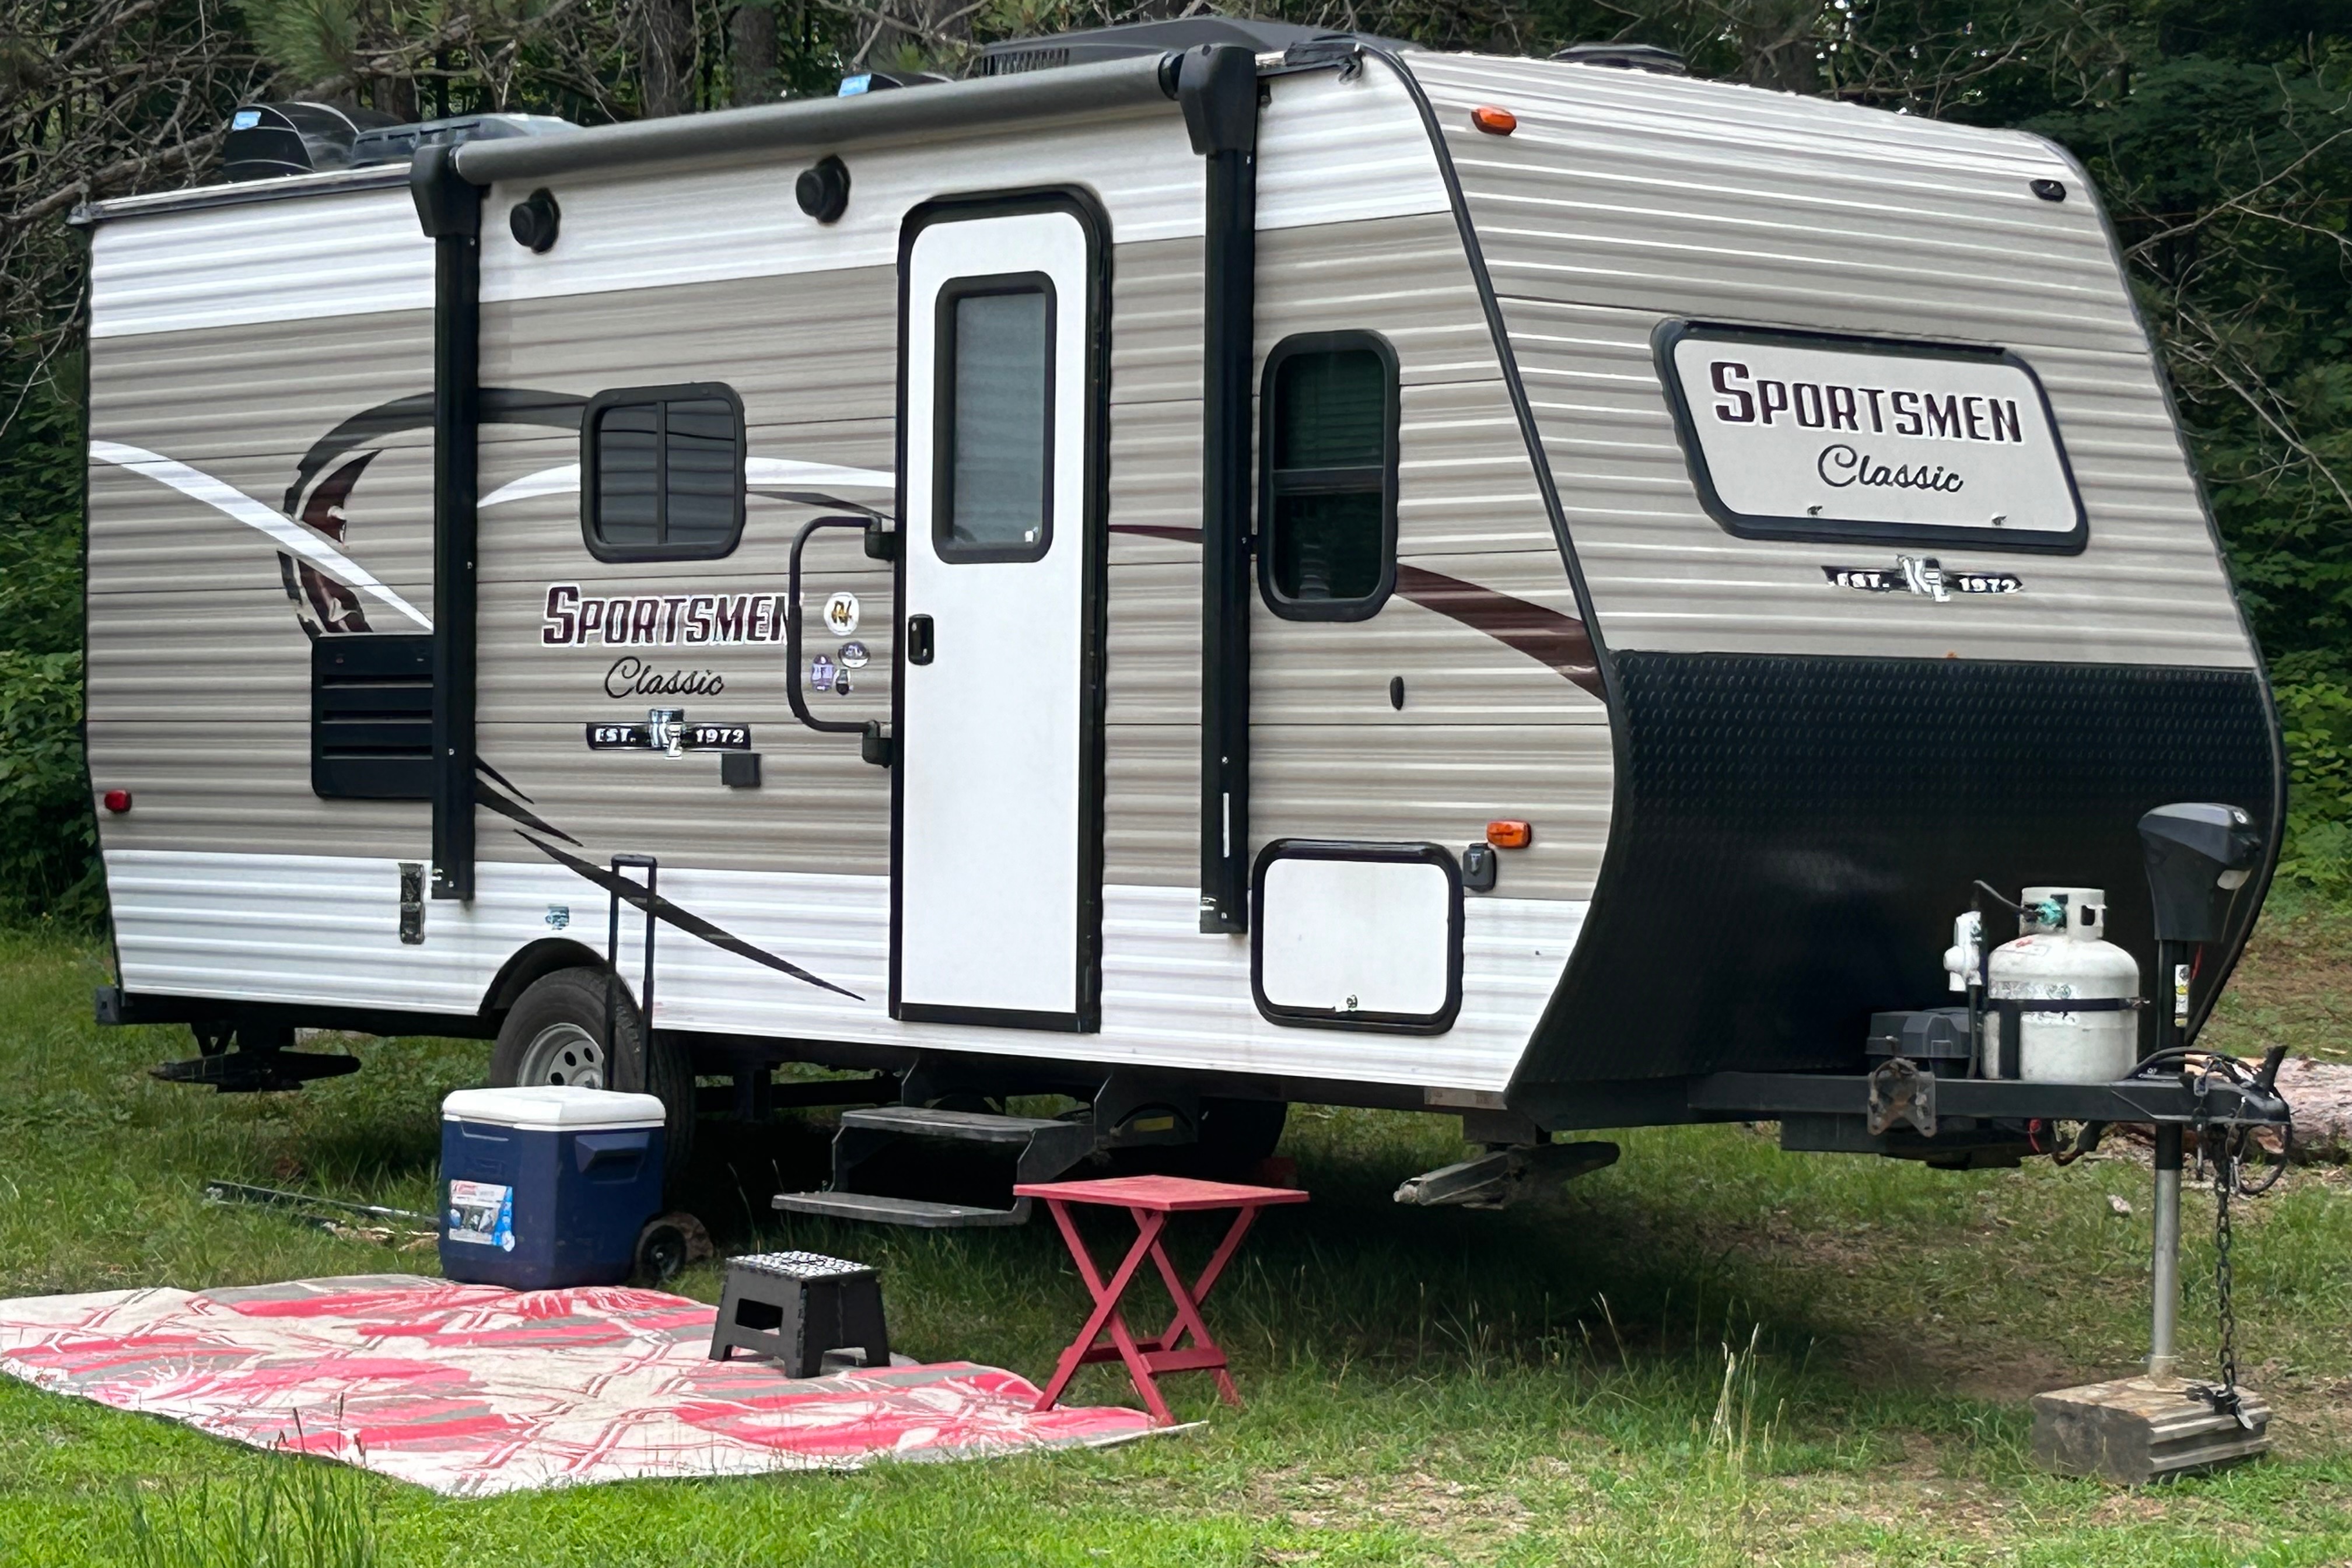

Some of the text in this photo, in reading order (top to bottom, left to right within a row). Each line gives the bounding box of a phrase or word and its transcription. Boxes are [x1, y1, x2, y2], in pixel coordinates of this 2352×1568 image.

[1710, 362, 2022, 442] SPORTSMEN
[1817, 444, 1964, 493] Classic
[1958, 576, 2019, 594] 1972
[604, 656, 724, 698] Classic
[594, 727, 637, 743] EST.
[695, 728, 745, 744] 1972
